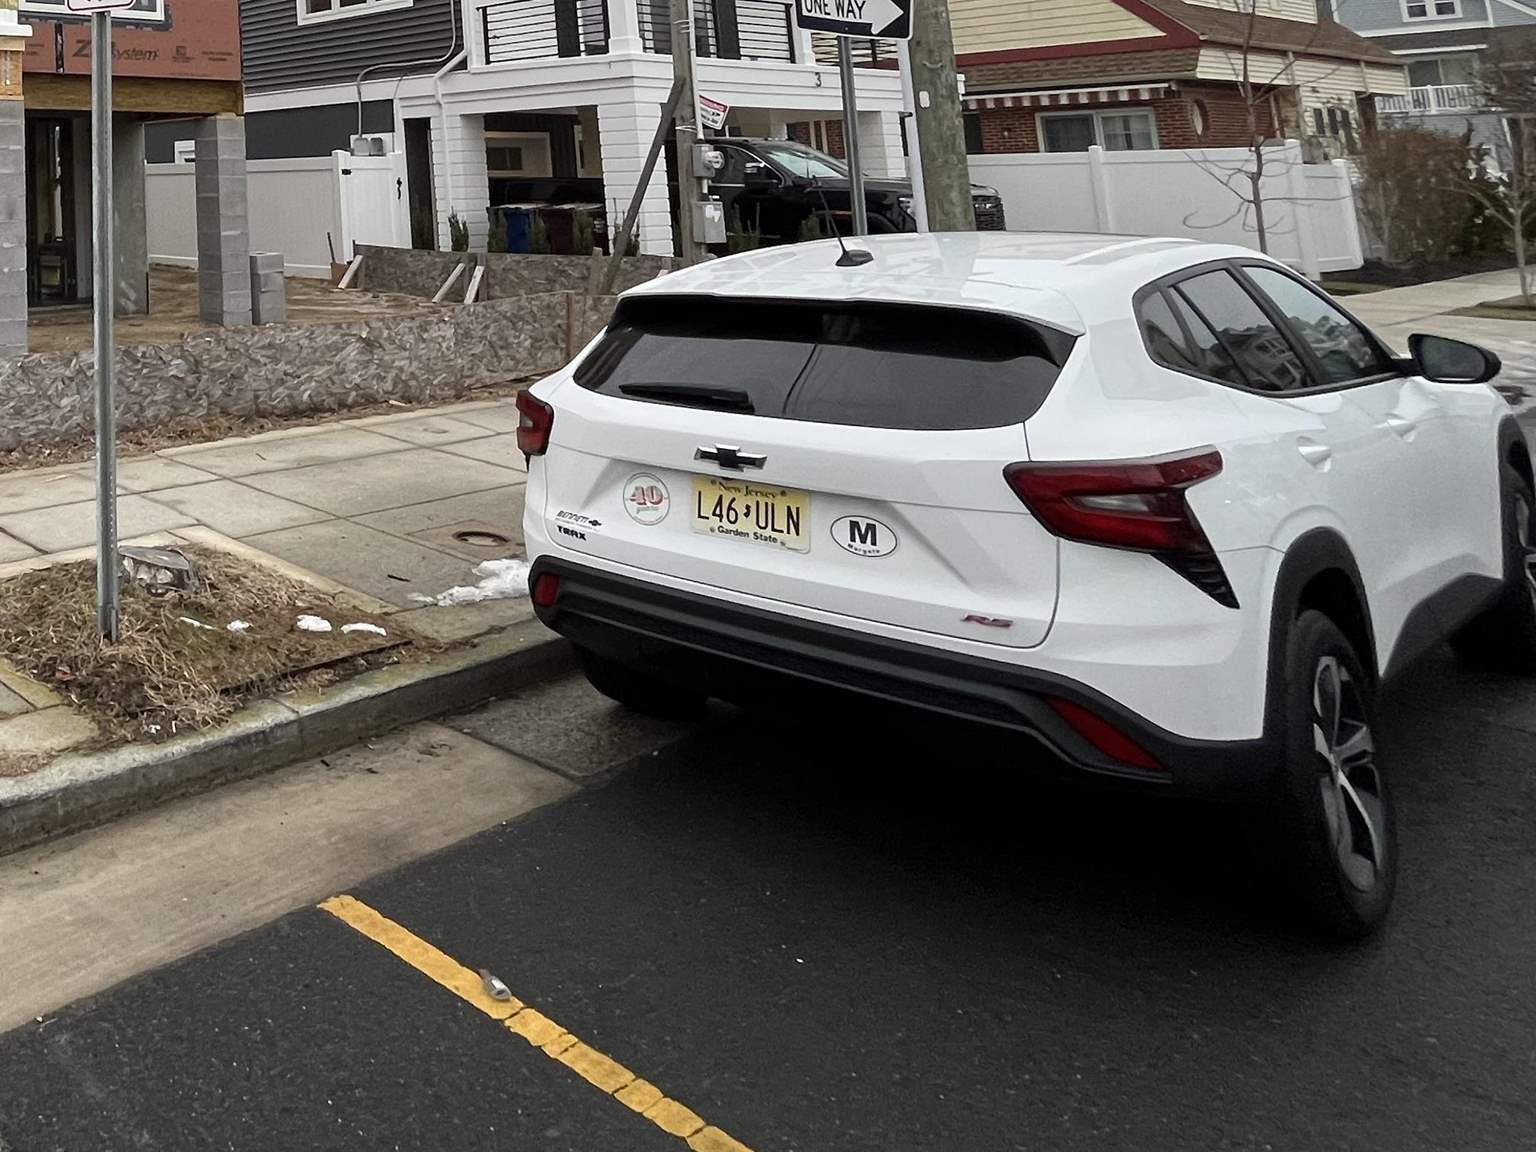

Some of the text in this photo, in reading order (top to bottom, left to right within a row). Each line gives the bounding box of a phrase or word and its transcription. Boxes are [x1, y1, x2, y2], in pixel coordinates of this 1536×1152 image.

[815, 72, 822, 87] 3
[718, 481, 776, 499] New Jersey
[697, 490, 800, 536] L46 ULN
[557, 524, 587, 541] TRAX
[717, 525, 778, 544] Garden State
[849, 520, 877, 546] M
